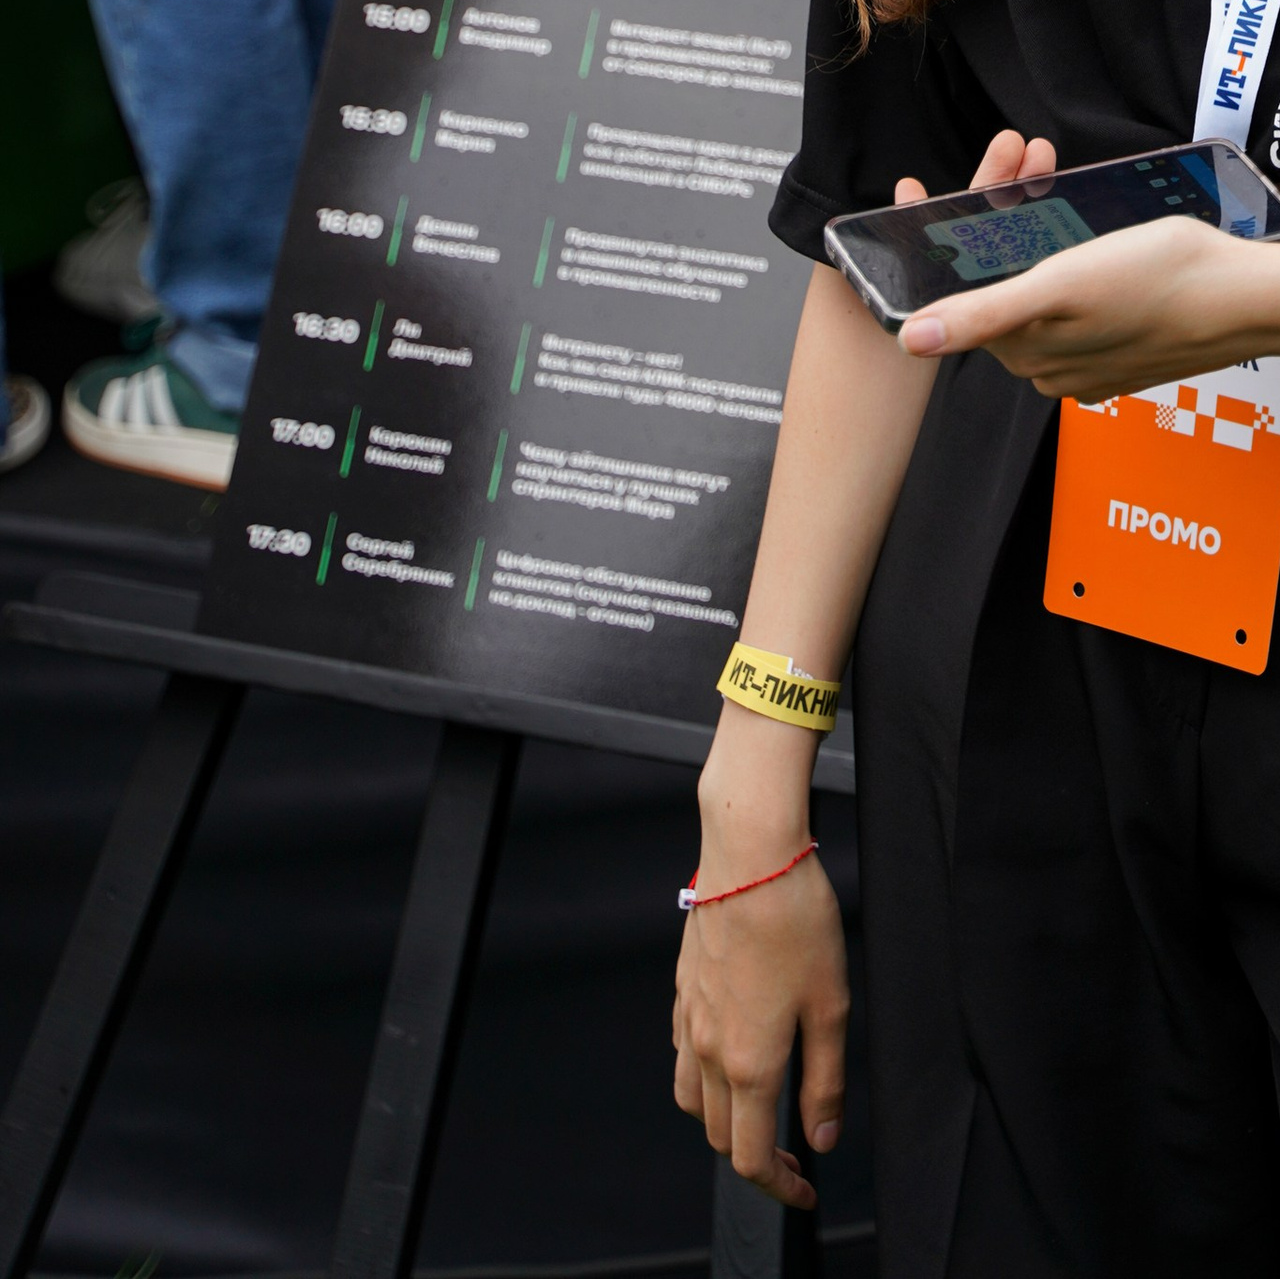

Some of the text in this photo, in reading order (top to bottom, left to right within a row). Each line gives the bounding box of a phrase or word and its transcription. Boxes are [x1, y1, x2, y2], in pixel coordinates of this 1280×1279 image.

[364, 3, 431, 33] 15:00
[341, 105, 408, 136] 15:30
[317, 208, 384, 239] 16:00
[293, 312, 360, 343] 16:30
[388, 338, 473, 367] Дмитрий
[271, 418, 335, 449] 17:00
[365, 446, 445, 475] Николай
[247, 524, 311, 556] 17:30
[1107, 499, 1222, 555] ПРОМО
[346, 533, 415, 560] Сергей
